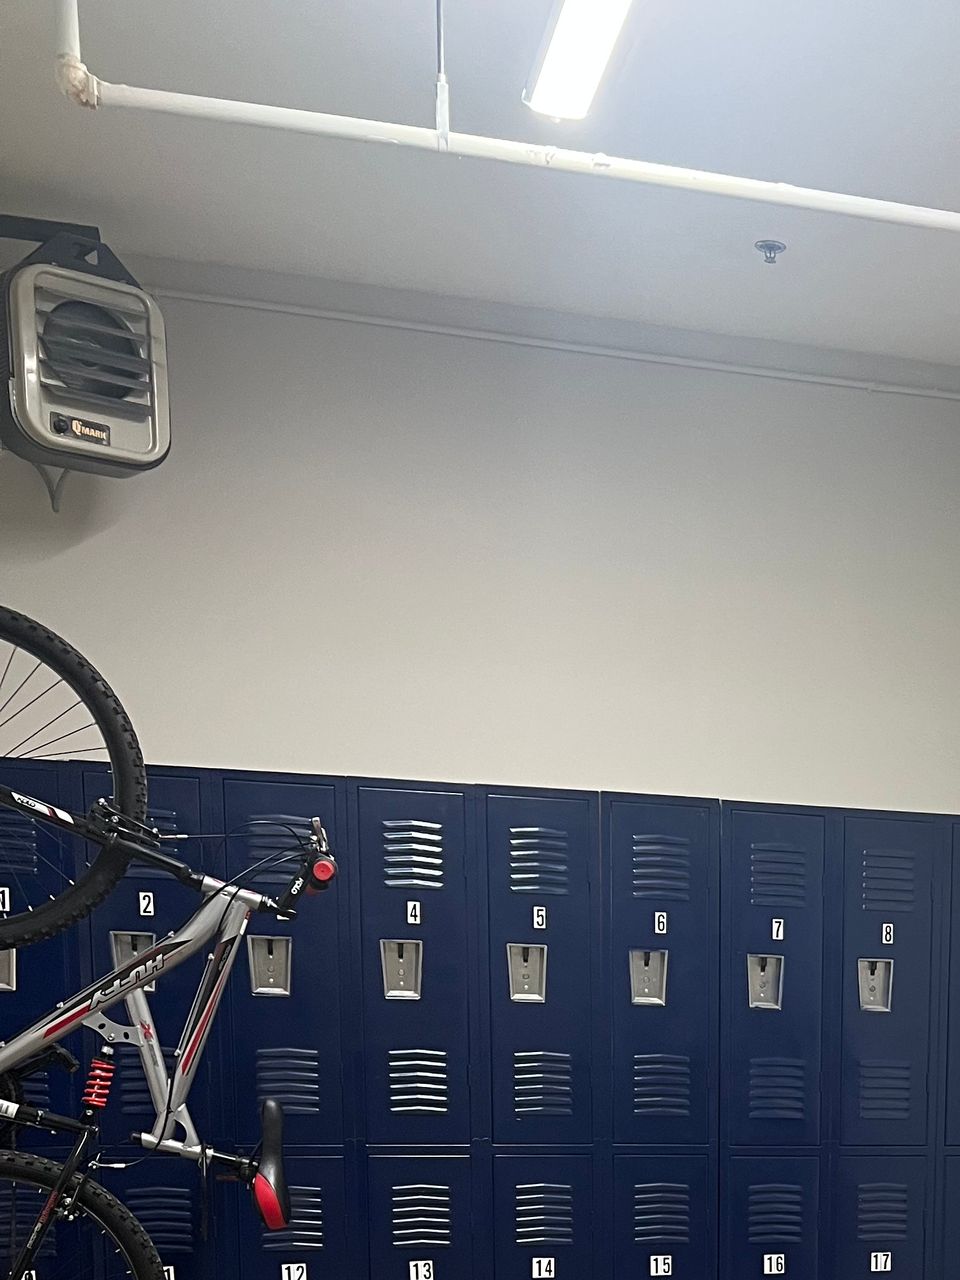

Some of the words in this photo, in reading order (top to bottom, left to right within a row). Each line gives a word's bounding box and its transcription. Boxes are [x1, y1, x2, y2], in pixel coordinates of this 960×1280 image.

[142, 894, 152, 914] 2
[409, 903, 419, 922] 4
[535, 908, 545, 927] 5
[657, 914, 666, 933] 6
[774, 920, 782, 939] 7
[884, 925, 893, 943] 8
[90, 953, 164, 1011] HUFFY
[535, 1259, 553, 1277] 14
[652, 1257, 671, 1275] 15
[766, 1255, 784, 1273] 16
[873, 1253, 890, 1270] 17
[412, 1262, 432, 1280] 13
